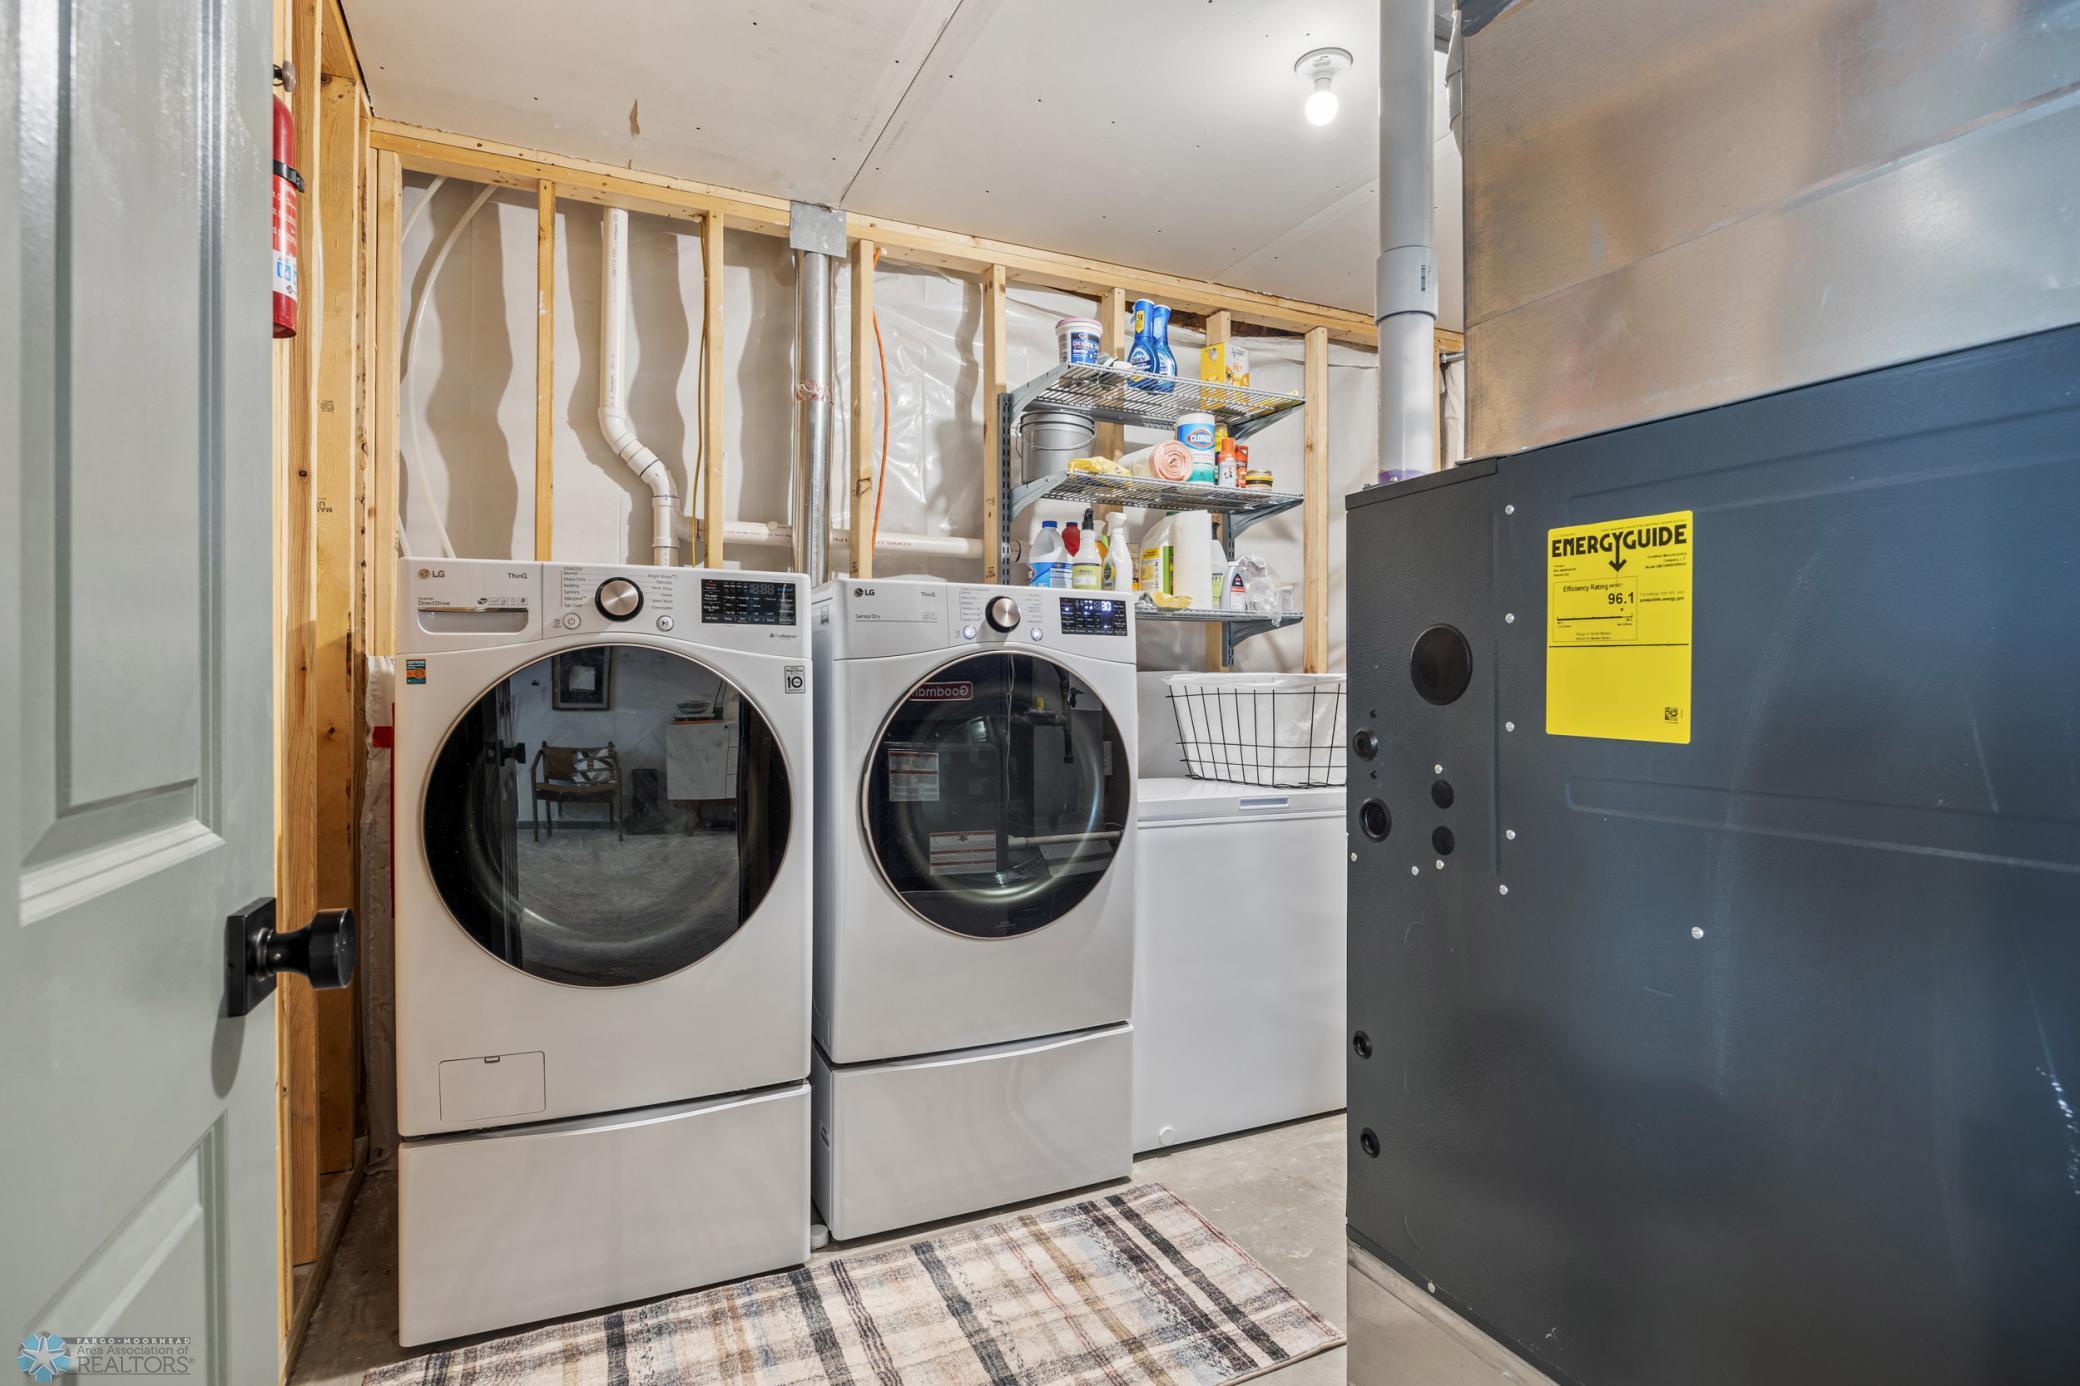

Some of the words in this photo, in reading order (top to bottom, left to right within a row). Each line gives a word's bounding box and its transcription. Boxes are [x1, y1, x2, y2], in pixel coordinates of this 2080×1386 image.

[1552, 524, 1687, 558] ENERGYGUIDE
[432, 570, 446, 578] LG
[507, 572, 528, 580] ThinQ
[1563, 585, 1589, 593] Efficiency
[1590, 583, 1608, 591] Rating
[1608, 591, 1634, 605] 96.1
